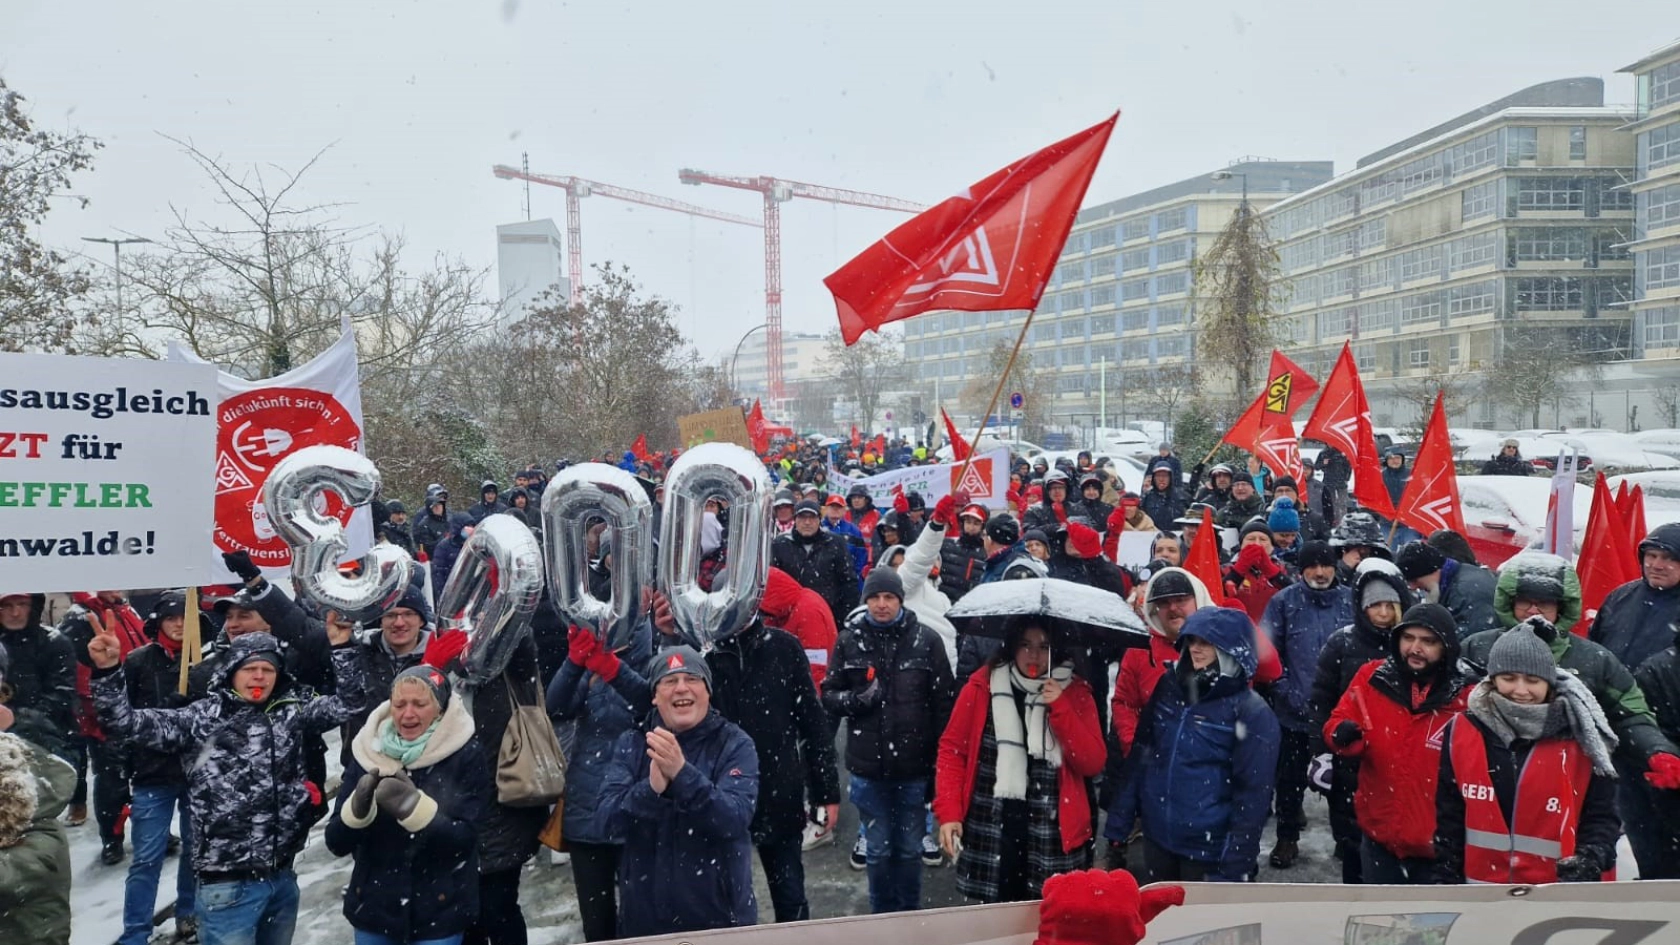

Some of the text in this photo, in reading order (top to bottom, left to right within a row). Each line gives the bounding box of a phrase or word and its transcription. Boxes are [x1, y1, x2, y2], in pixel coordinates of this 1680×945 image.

[0, 387, 210, 419] sausgleich
[61, 434, 122, 460] für
[0, 482, 153, 508] EFFLER
[0, 531, 155, 557] nwalde!
[1462, 783, 1494, 802] GEBT
